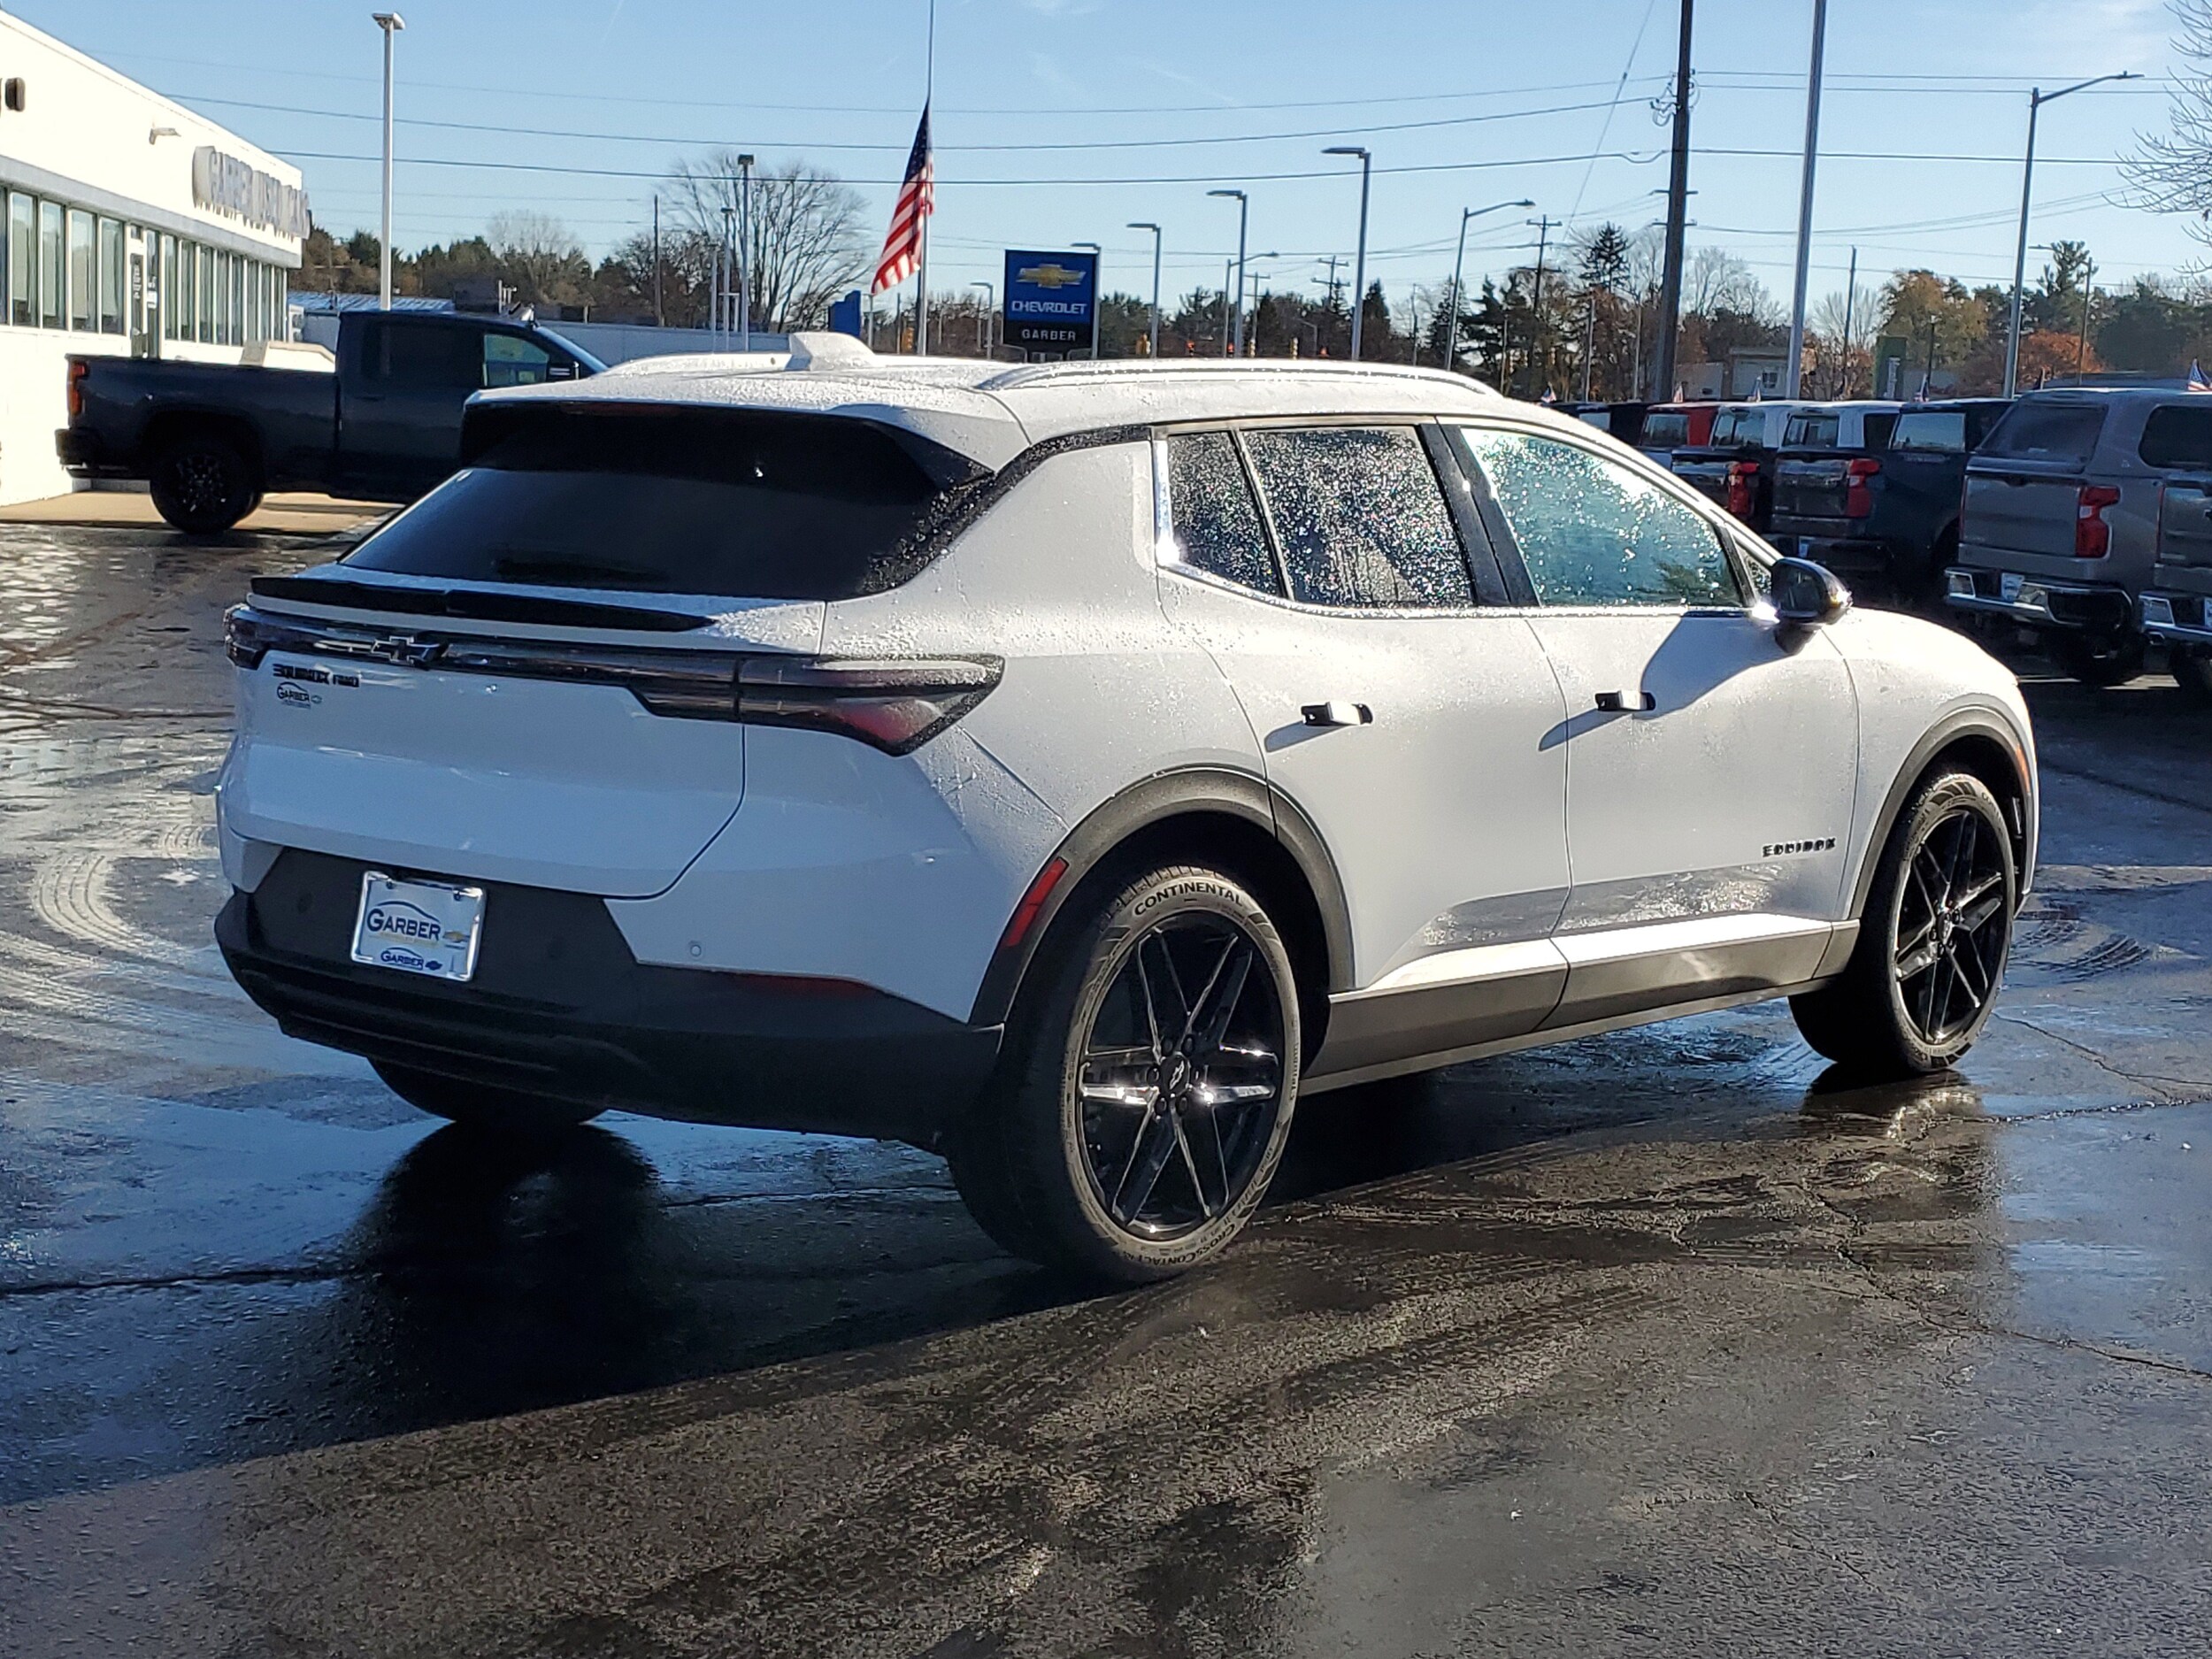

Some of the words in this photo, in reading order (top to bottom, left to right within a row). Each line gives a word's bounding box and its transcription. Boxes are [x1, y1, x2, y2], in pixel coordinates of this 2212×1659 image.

[1011, 301, 1087, 314] CHEVROLET
[1022, 328, 1076, 342] GARBER
[1762, 837, 1836, 857] EQUINOX
[1134, 882, 1243, 916] CONTINENTAL
[366, 909, 441, 941] GARBER
[380, 950, 424, 970] GARBER
